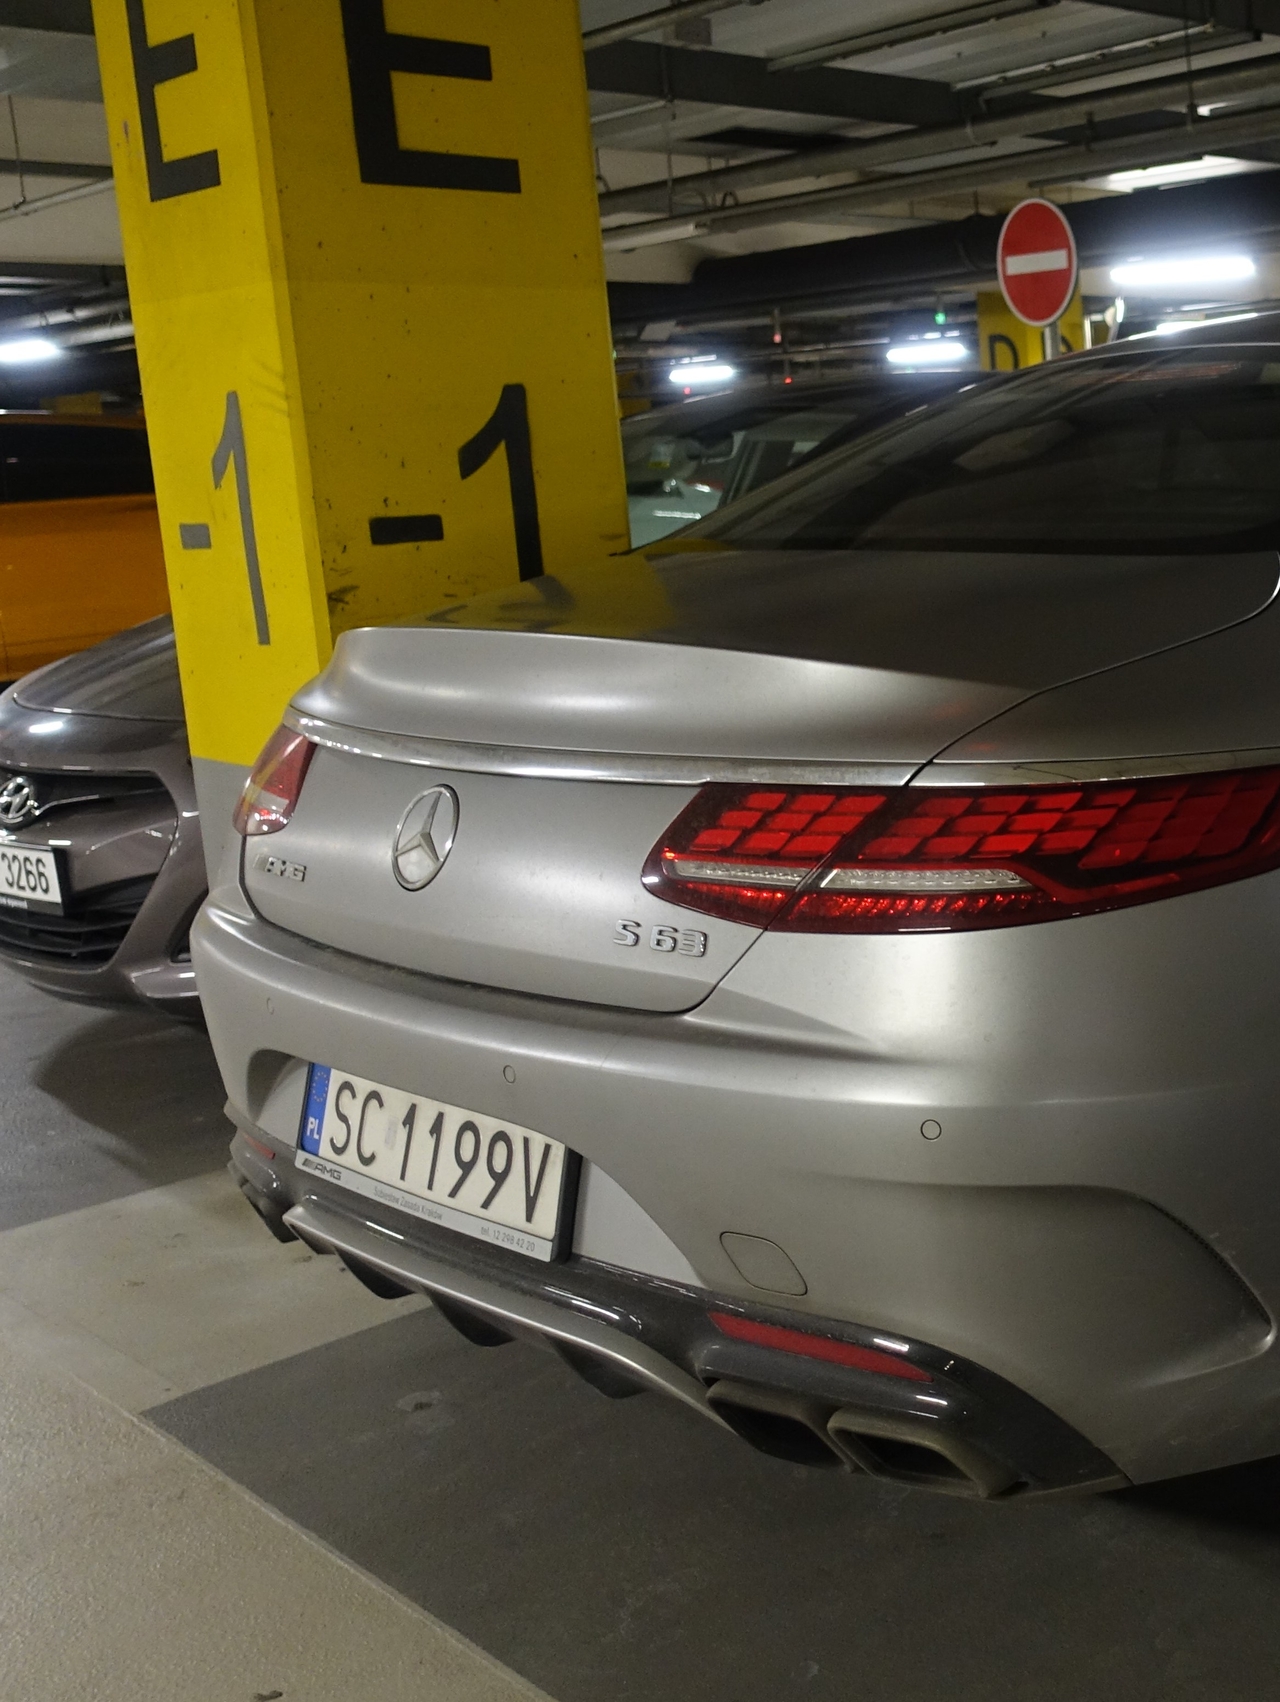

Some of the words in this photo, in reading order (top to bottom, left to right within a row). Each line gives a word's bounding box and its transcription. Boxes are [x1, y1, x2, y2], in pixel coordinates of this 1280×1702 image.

[126, 0, 221, 202] E
[340, 0, 521, 193] E
[179, 390, 271, 646] -1
[368, 383, 545, 582] -1
[1, 853, 50, 895] 3266
[613, 919, 642, 947] S
[649, 925, 708, 957] 63
[307, 1116, 320, 1140] PL
[313, 1163, 342, 1181] AMG
[330, 1080, 384, 1167] SC
[399, 1102, 552, 1224] 1199V
